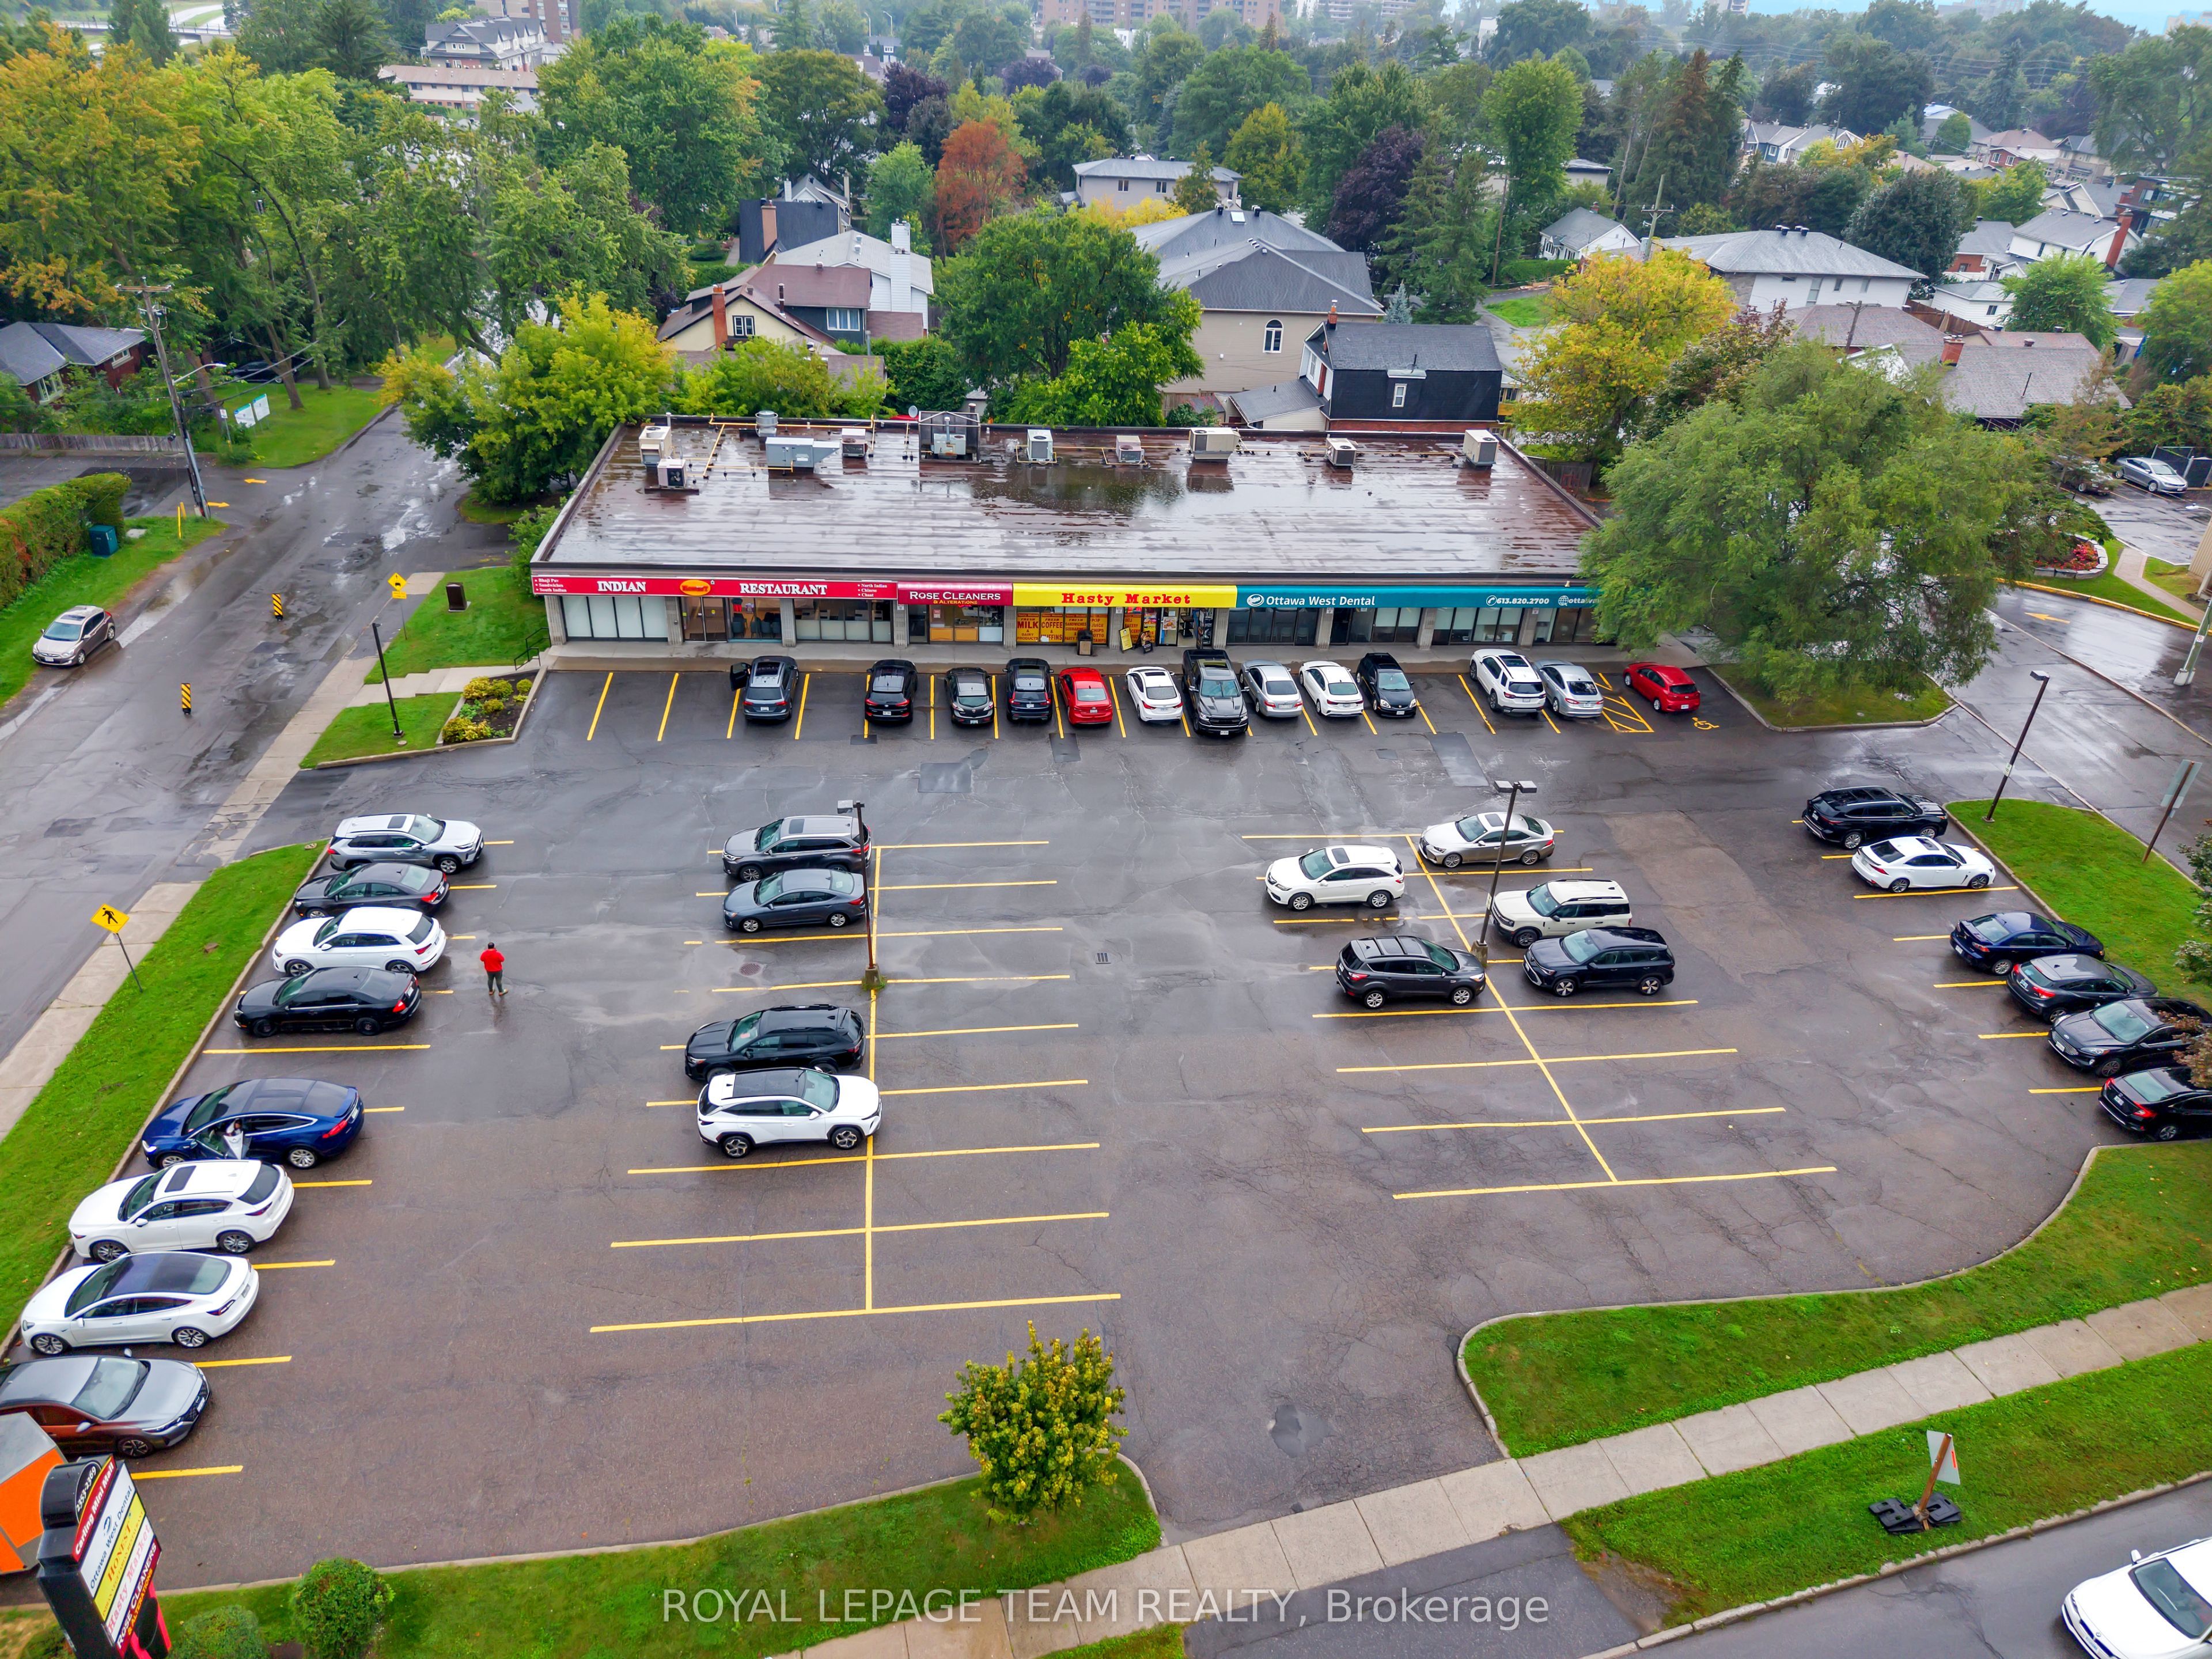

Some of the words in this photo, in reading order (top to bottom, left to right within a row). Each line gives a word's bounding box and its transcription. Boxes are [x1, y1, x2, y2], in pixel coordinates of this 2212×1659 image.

[597, 581, 646, 592] INDIAN
[740, 583, 827, 595] RESTAURANT
[1062, 593, 1114, 606] Hasty
[1125, 593, 1191, 604] Market
[1266, 596, 1305, 605] Ottawa
[1309, 596, 1336, 605] West
[1339, 596, 1375, 605] Dental
[75, 1512, 94, 1555] Carling
[91, 1486, 104, 1514] Mini
[102, 1461, 114, 1488] Mall
[90, 1551, 107, 1589] Ottawa
[106, 1521, 119, 1548] West
[117, 1485, 132, 1521] Dental
[107, 1582, 128, 1634] Hasty
[126, 1524, 150, 1582] Market
[116, 1610, 132, 1650] ROSE
[130, 1542, 157, 1609] CLEANERS
[127, 1627, 132, 1636] &
[131, 1568, 153, 1626] ALTERATIONS
